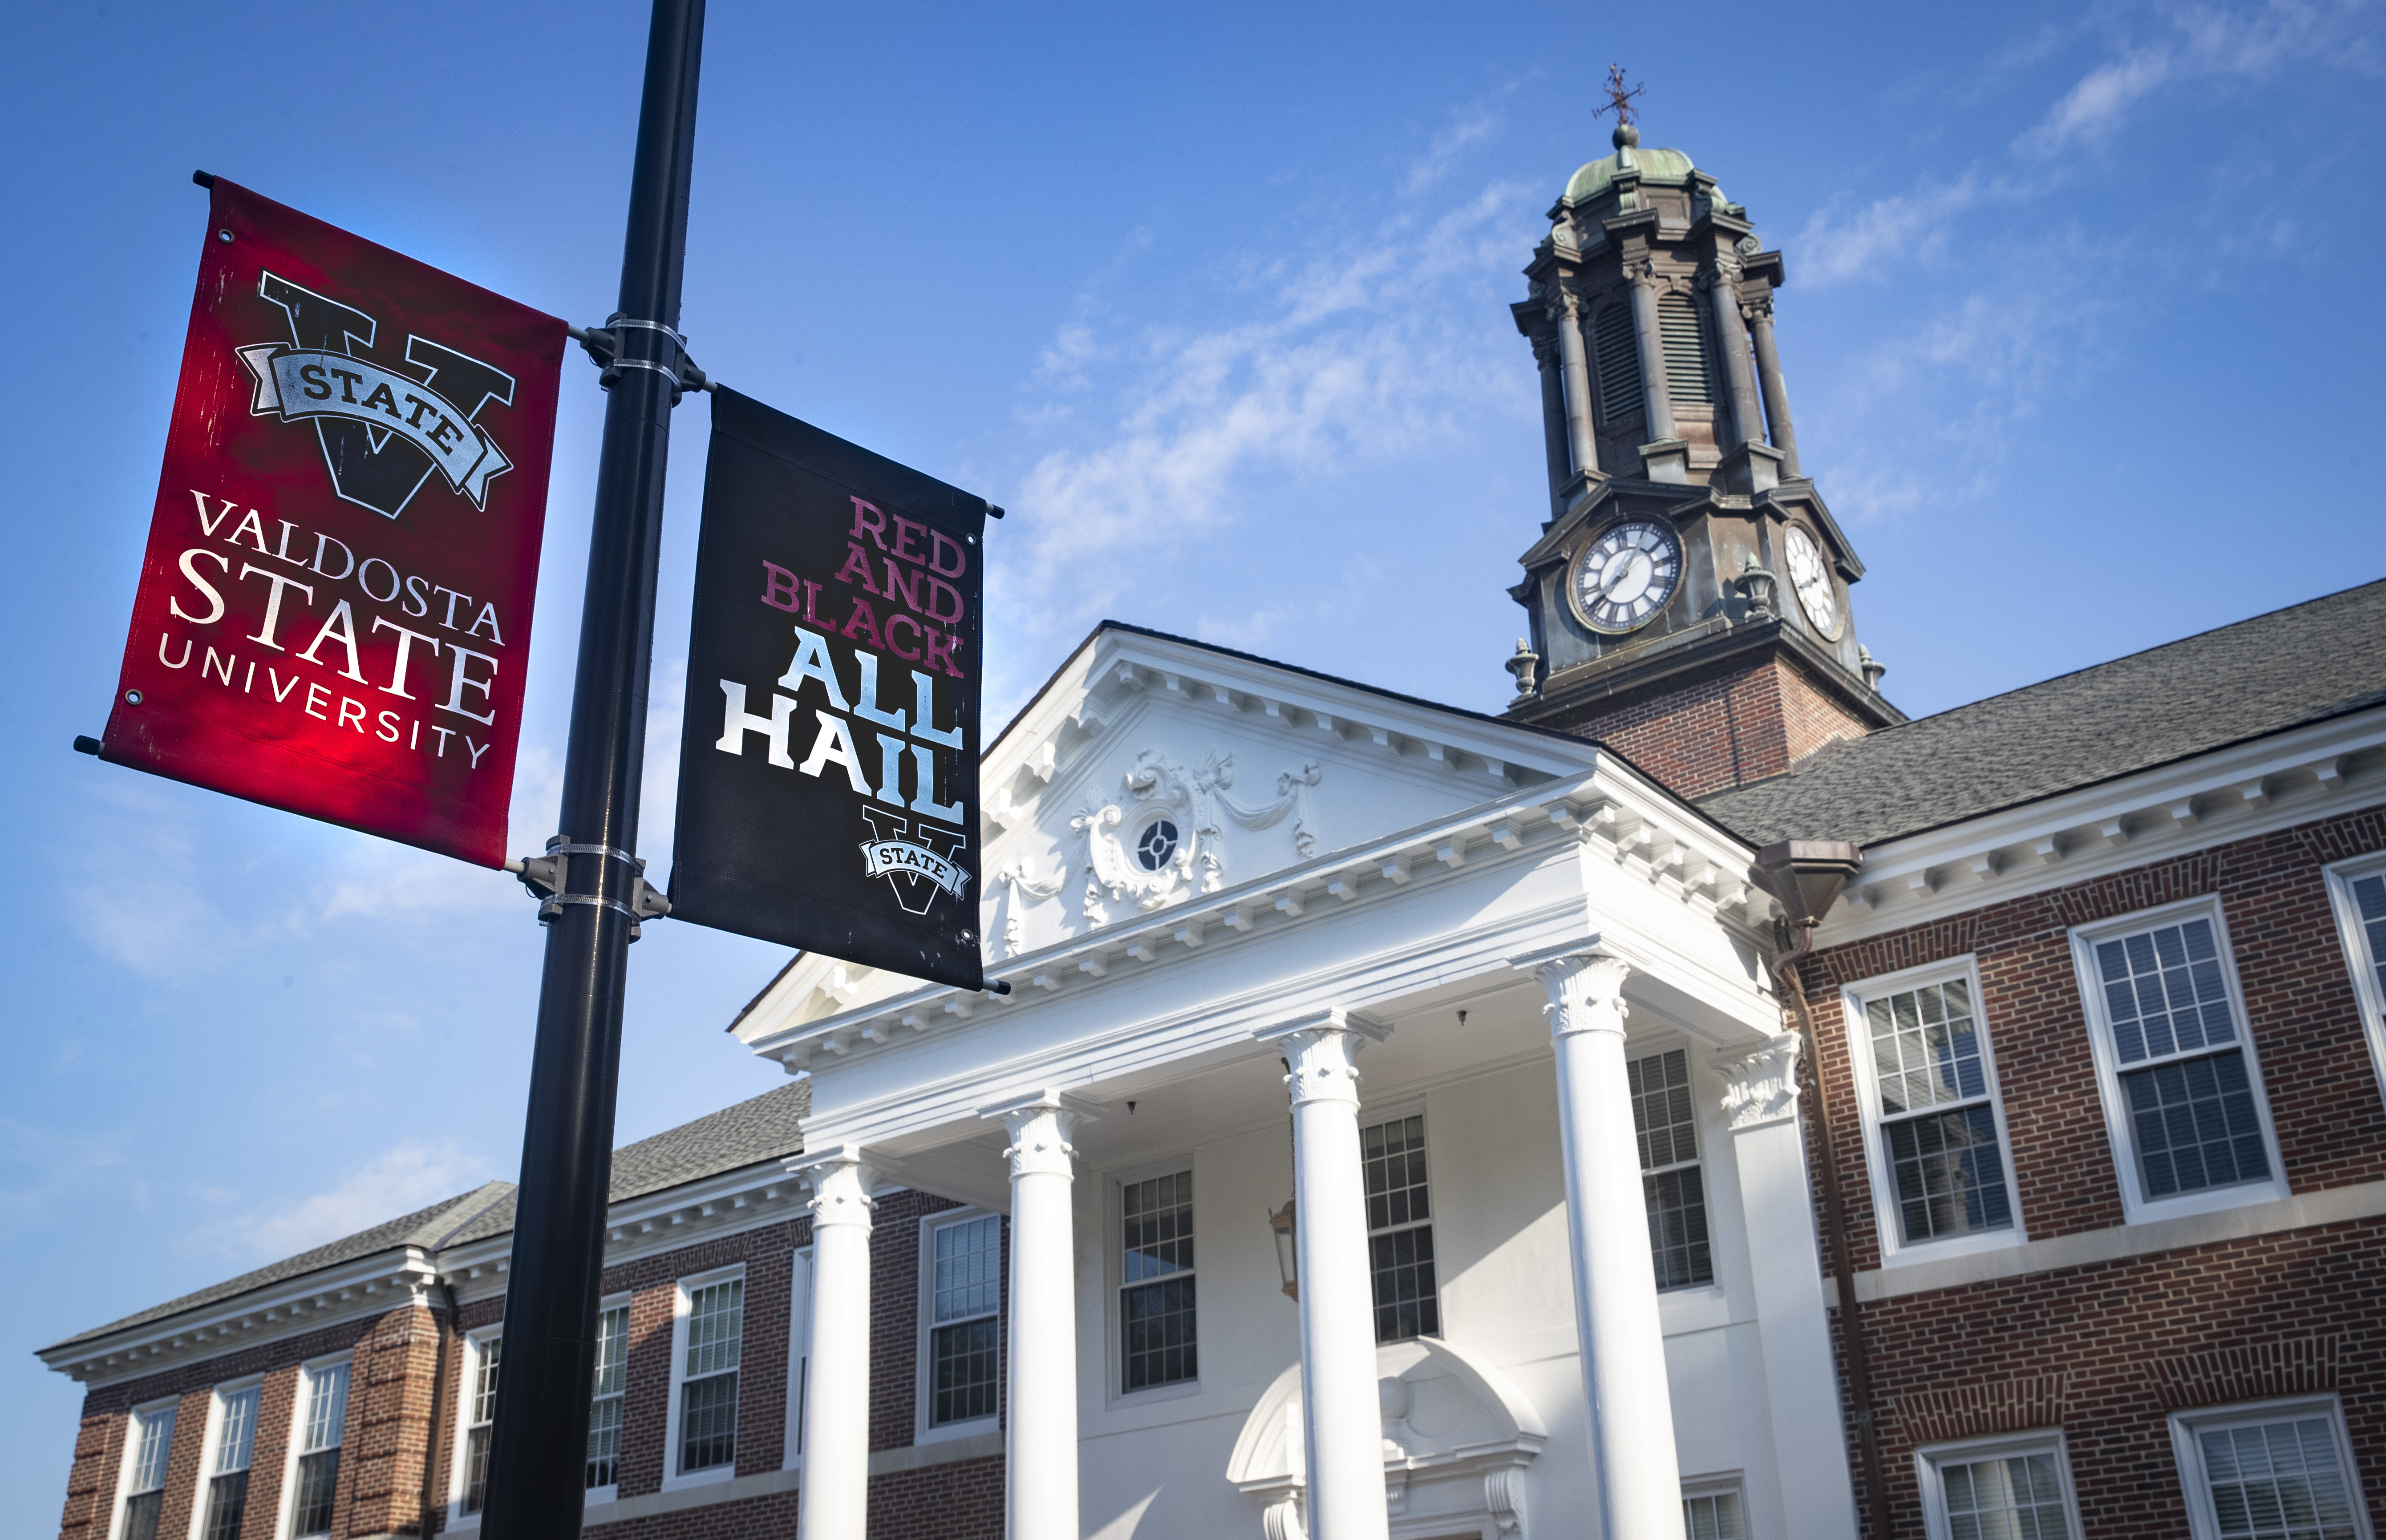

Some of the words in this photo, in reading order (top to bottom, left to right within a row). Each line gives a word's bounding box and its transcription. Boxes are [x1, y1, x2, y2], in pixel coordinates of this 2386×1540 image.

[300, 364, 465, 456] STATE
[190, 489, 505, 647] VALDOSTA
[834, 541, 964, 624] AND
[849, 494, 966, 578] RED
[170, 548, 499, 727] STATE
[761, 559, 964, 679] BLACK
[158, 633, 490, 769] UNIVERSITY
[778, 625, 963, 750] ALL
[715, 678, 964, 825] HAIL
[879, 847, 948, 879] STATE
